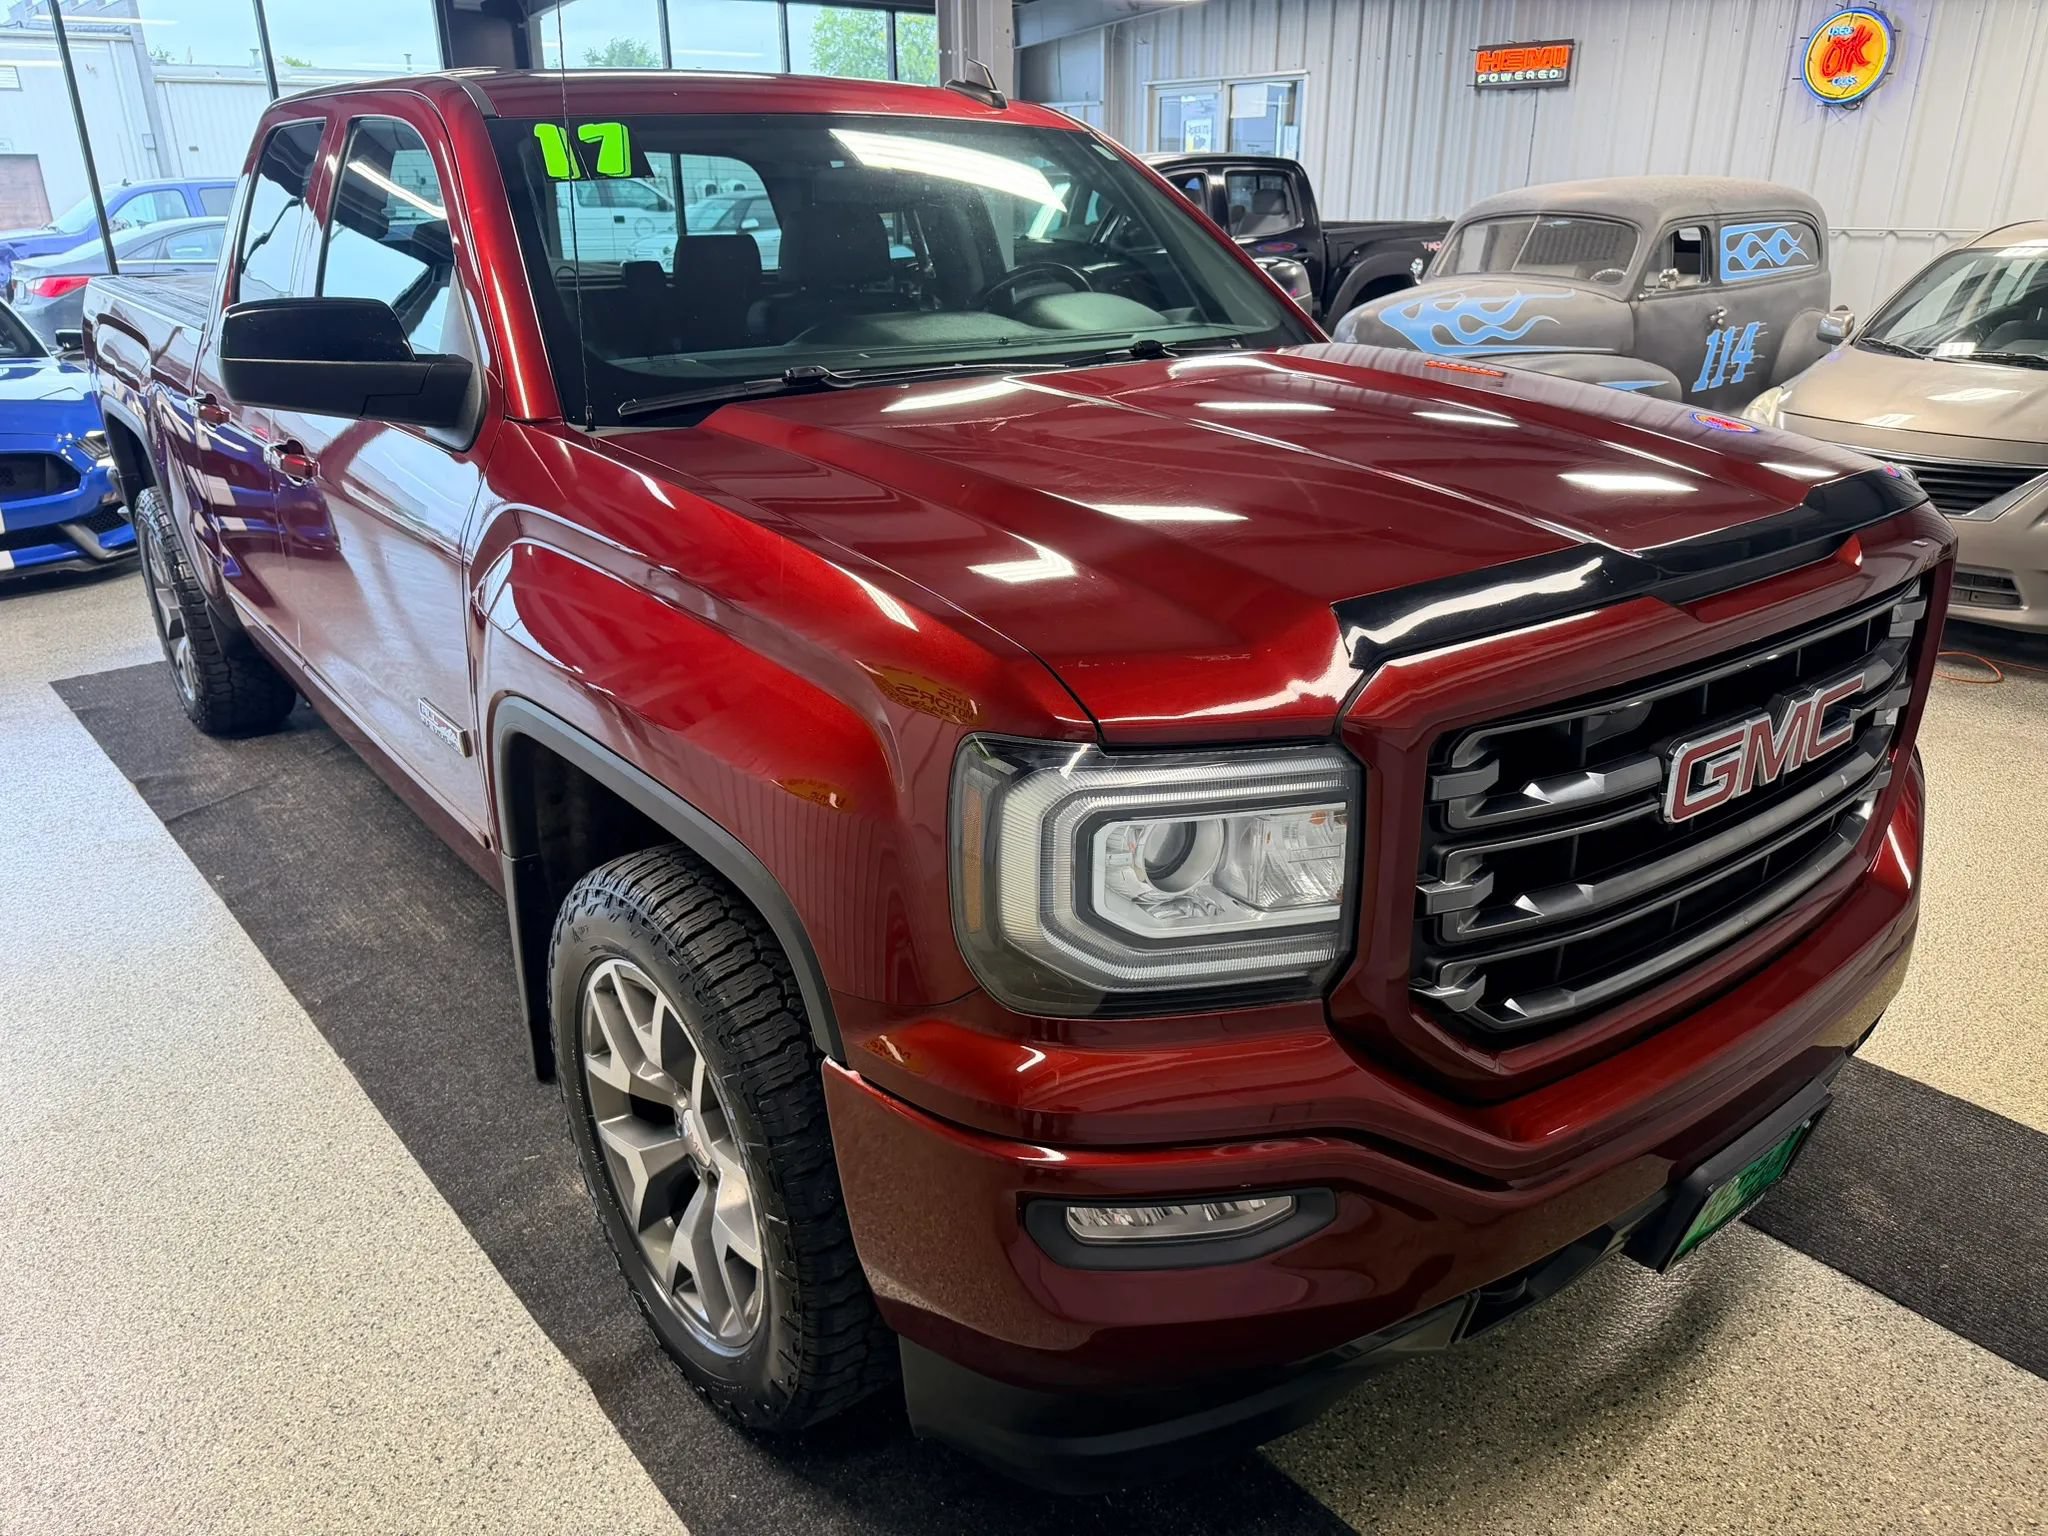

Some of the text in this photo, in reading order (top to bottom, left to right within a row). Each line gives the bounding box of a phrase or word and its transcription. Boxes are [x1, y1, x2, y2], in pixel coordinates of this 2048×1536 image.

[1476, 45, 1569, 72] HEMI
[1477, 69, 1559, 83] POWERED
[1822, 24, 1873, 77] OK
[533, 122, 632, 180] 17
[1691, 321, 1761, 393] 114
[1663, 671, 1865, 824] GMC
